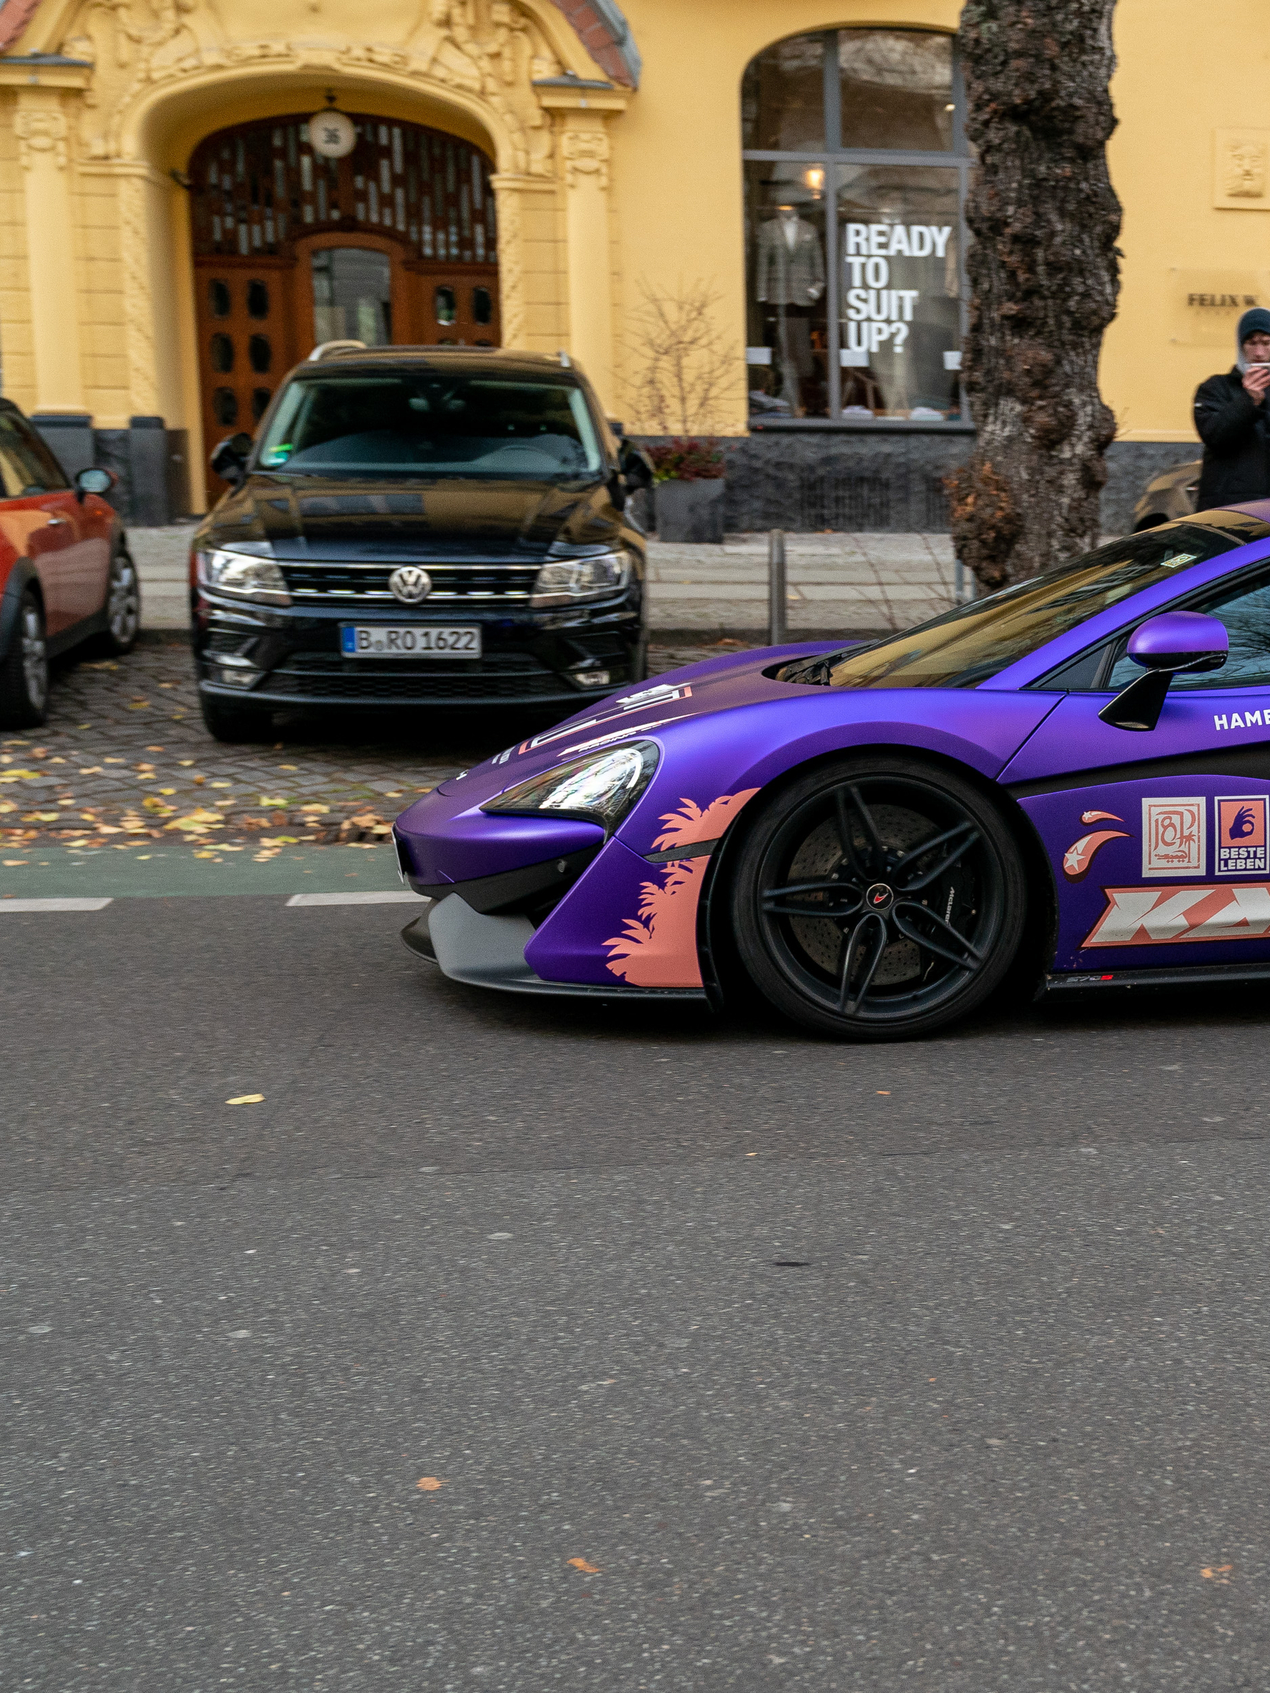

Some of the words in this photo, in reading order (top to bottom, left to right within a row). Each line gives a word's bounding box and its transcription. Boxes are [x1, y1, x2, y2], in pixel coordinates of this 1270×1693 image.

[845, 223, 952, 257] READY
[845, 256, 889, 288] TO
[846, 288, 919, 321] SUIT
[1187, 293, 1239, 307] FELIX
[847, 321, 909, 353] UP?
[358, 630, 372, 651] B
[386, 630, 417, 651] RO
[421, 631, 477, 651] 1622
[1220, 847, 1265, 859] BESTE
[1220, 858, 1265, 871] LEBEN
